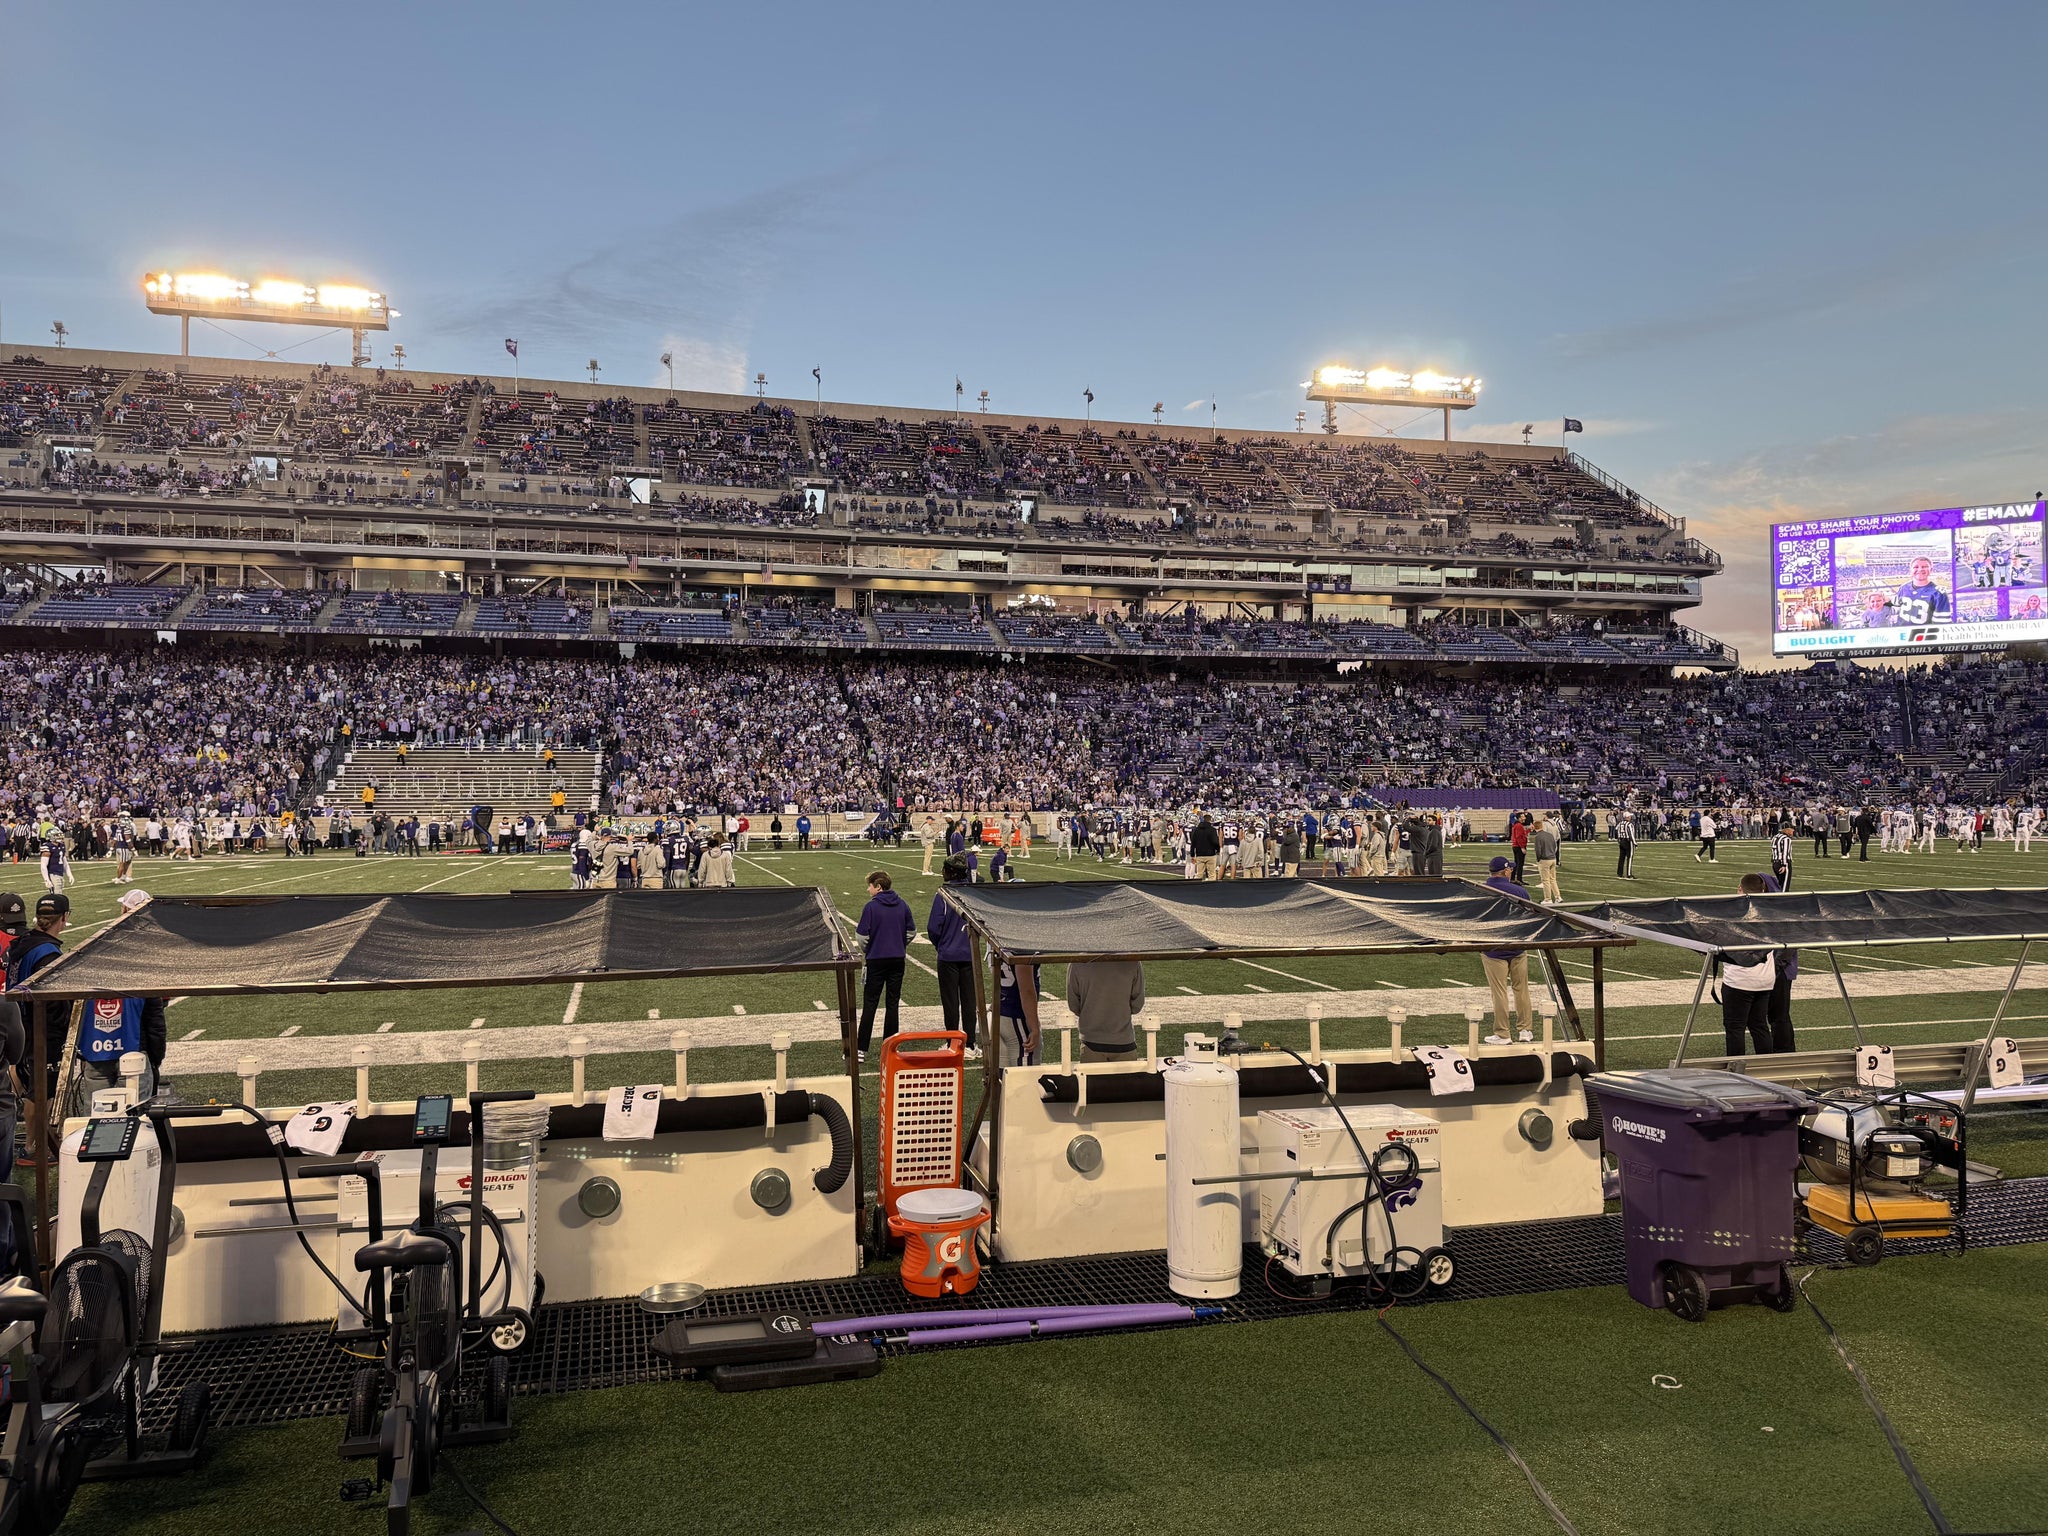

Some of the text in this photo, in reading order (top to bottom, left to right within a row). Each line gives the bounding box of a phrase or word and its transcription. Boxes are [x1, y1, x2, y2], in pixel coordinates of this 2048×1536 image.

[1962, 504, 2037, 521] #EMAW
[1778, 514, 1921, 533] SCAN TO SHARE YOUR PHOTOS
[1899, 597, 1928, 625] 23
[126, 622, 173, 631] MICHAEL
[177, 623, 216, 631] BISHOP
[219, 624, 262, 632] 1997-98
[291, 625, 322, 634] MARK
[326, 626, 379, 635] SIMONEAU
[451, 630, 481, 638] DAVID
[483, 631, 515, 639] ALLEN
[587, 634, 613, 642] JAIME
[615, 635, 653, 643] MENDEZ
[1790, 635, 1856, 647] BUD LIGHT
[1942, 631, 1999, 641] Health Plans
[713, 637, 740, 646] STEVE
[742, 639, 780, 647] GROGAN
[1848, 648, 1877, 656] MARY
[1880, 647, 1896, 655] ICE
[1898, 646, 1937, 655] FAMILY
[1938, 644, 1969, 652] VIDEO
[1971, 643, 2008, 651] BOARD
[1222, 826, 1238, 839] 86
[672, 842, 688, 860] 19
[92, 1038, 124, 1053] 061
[1453, 1060, 1468, 1075] G
[313, 1116, 333, 1132] G
[879, 1062, 888, 1195] GATORADE
[1623, 1119, 1667, 1140] HOWIE'S
[1405, 1128, 1440, 1137] DRAGON
[1404, 1136, 1430, 1144] SEATS
[484, 1173, 528, 1183] DRAGON
[482, 1183, 514, 1192] SEATS
[939, 1234, 962, 1263] G
[133, 1367, 143, 1440] ROGUE
